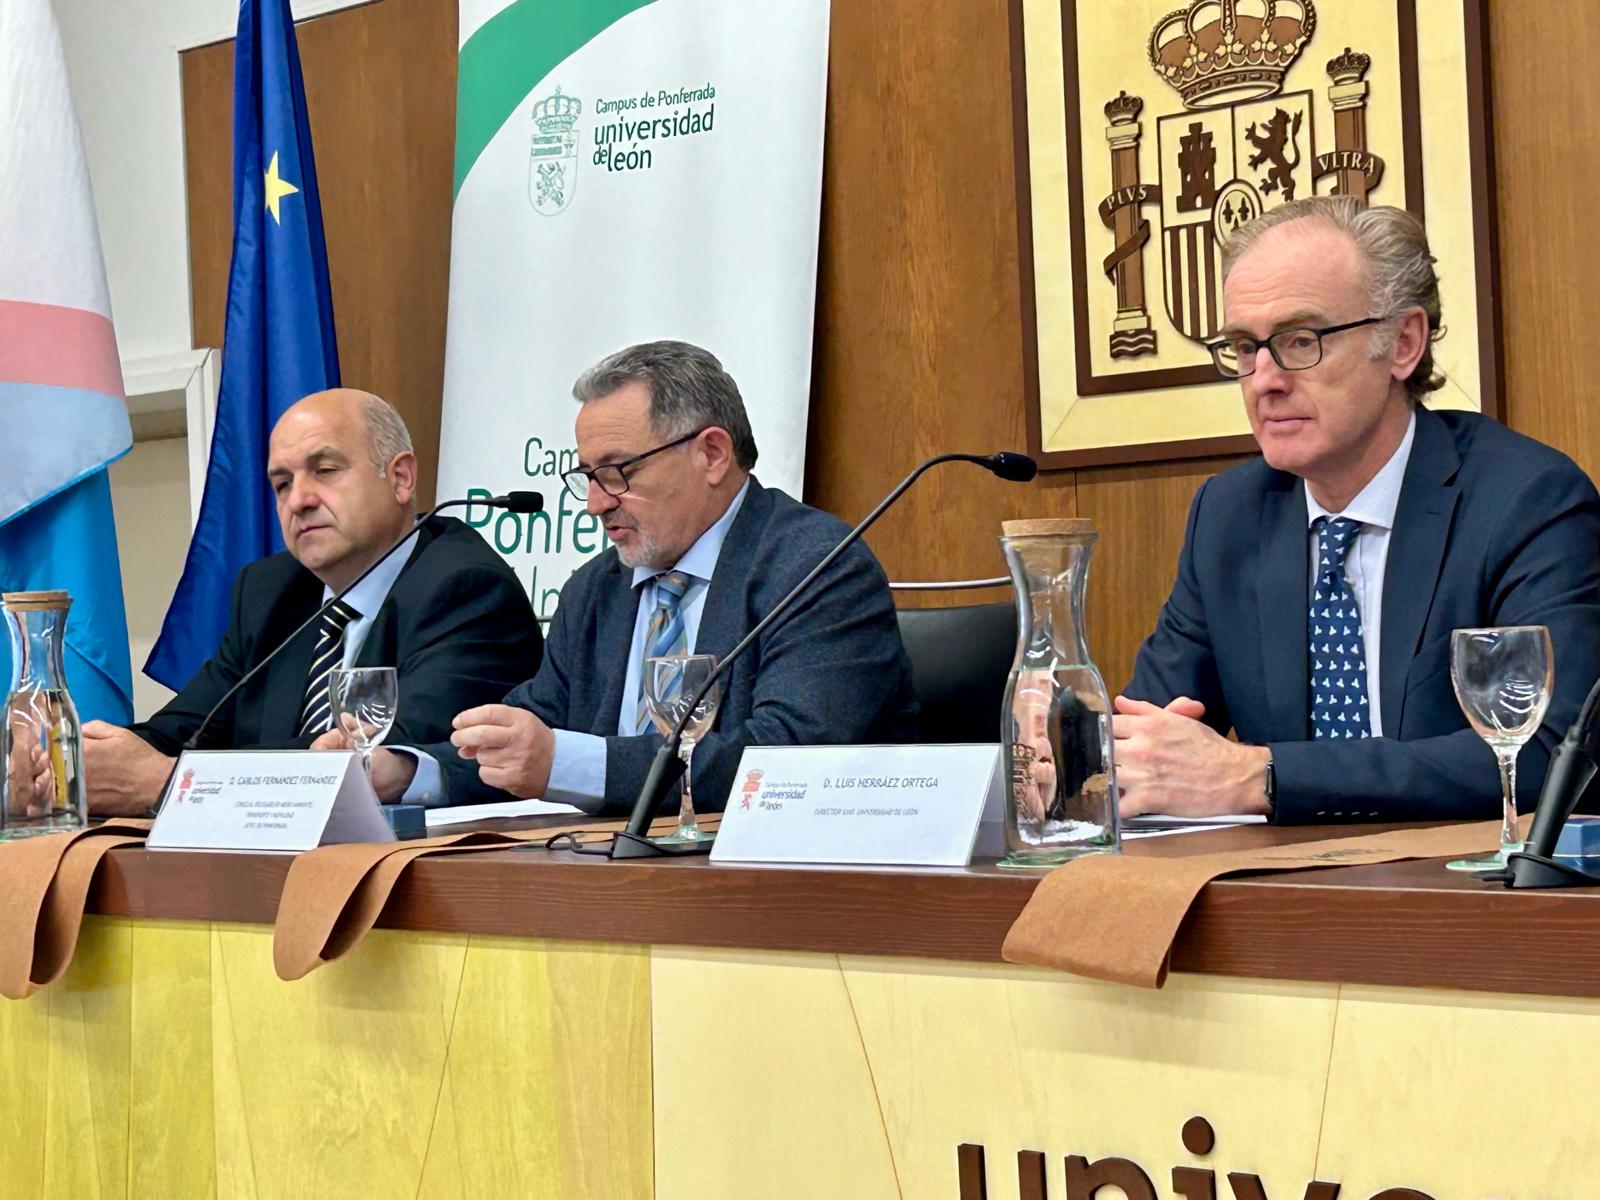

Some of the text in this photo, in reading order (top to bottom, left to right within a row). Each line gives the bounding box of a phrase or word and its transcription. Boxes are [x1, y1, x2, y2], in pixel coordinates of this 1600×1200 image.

[595, 82, 716, 115] Campus de Ponferrada
[594, 103, 715, 145] universidad
[593, 142, 652, 172] de león
[1318, 152, 1375, 177] VLTRA
[1106, 185, 1148, 210] PLVS
[823, 776, 938, 788] D. LUIS HERRÁEZ ORTEGA
